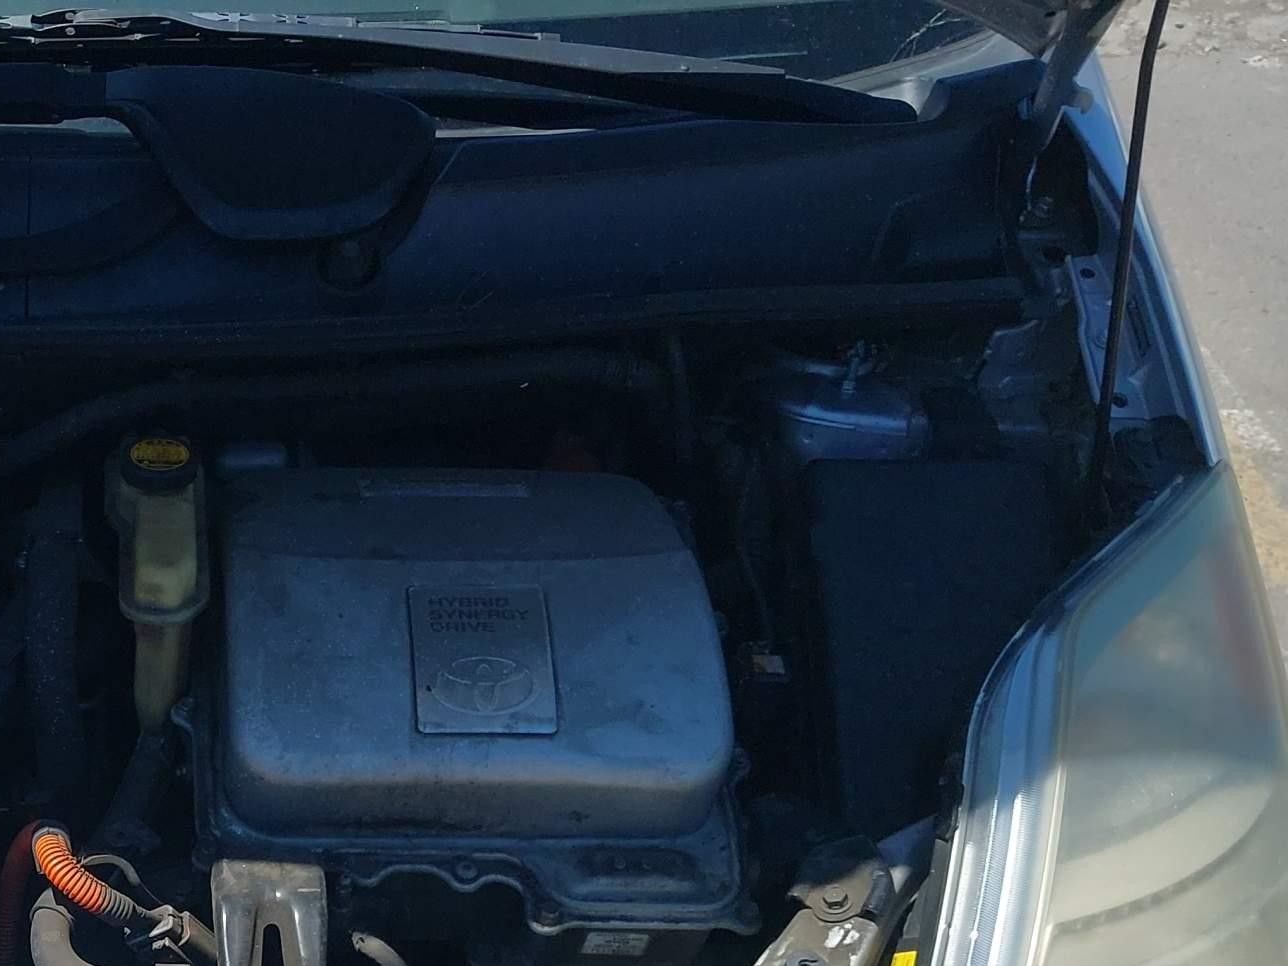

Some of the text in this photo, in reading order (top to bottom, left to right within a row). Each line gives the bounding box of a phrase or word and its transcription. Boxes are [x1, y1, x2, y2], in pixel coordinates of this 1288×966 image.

[428, 597, 510, 608] HYBRID
[428, 608, 529, 620] SYNERGY
[430, 621, 497, 632] DRIVE
